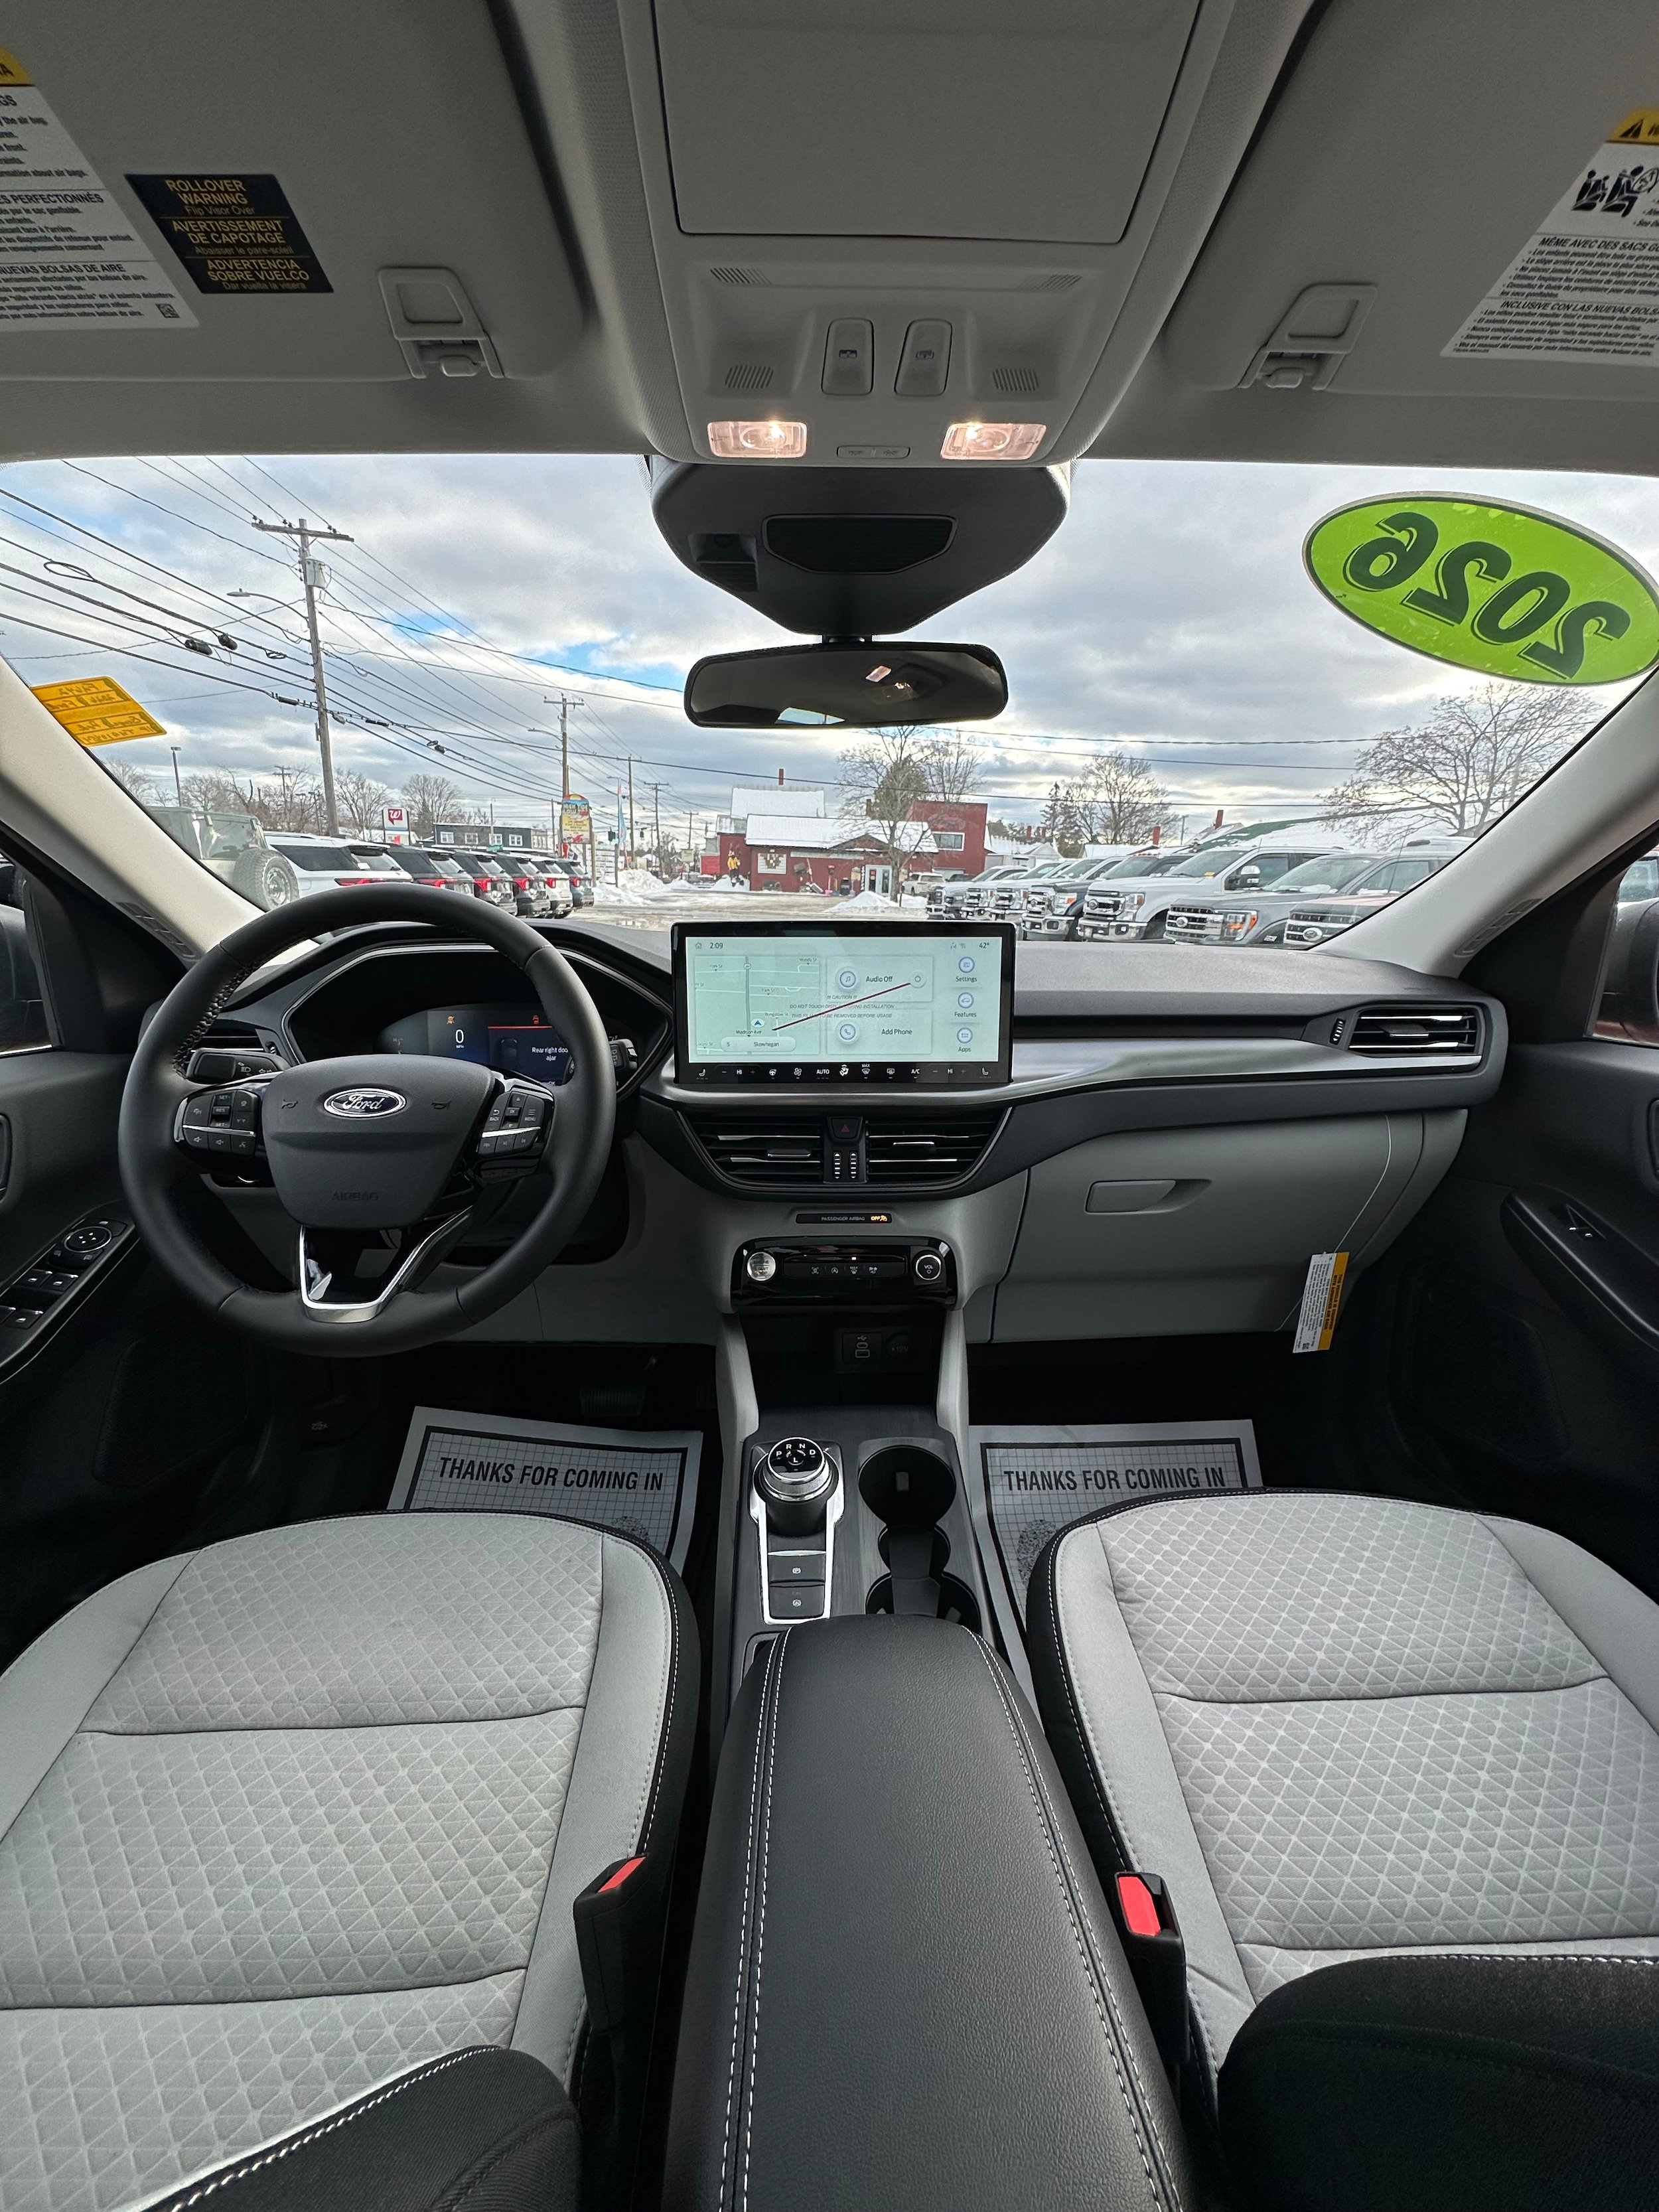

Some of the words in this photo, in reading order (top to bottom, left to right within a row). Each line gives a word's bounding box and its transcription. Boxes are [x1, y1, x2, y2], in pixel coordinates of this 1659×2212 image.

[166, 180, 246, 192] ROLLOVER
[11, 193, 103, 203] PERFECTIONNÉS
[179, 193, 248, 205] WARNING
[207, 206, 230, 216] Visor
[232, 206, 255, 216] Over
[172, 220, 283, 232] AVERTISSEMENT
[187, 233, 207, 244] DE
[210, 233, 286, 244] CAPOTAGE
[206, 259, 300, 269] ADVERTENCIA
[208, 271, 255, 281] SOBRE
[256, 271, 310, 281] VUELCO
[1502, 300, 1550, 309] INCLUSIVE
[455, 1029, 465, 1044] 0
[342, 1094, 385, 1110] Ford
[438, 1457, 515, 1484] THANKS
[519, 1465, 559, 1487] FOR
[563, 1468, 638, 1491] COMING
[644, 1472, 664, 1491] IN
[1004, 1470, 1077, 1491] THANKS
[1082, 1469, 1121, 1490] FOR
[1125, 1467, 1201, 1490] COMING
[1204, 1467, 1226, 1487] IN
